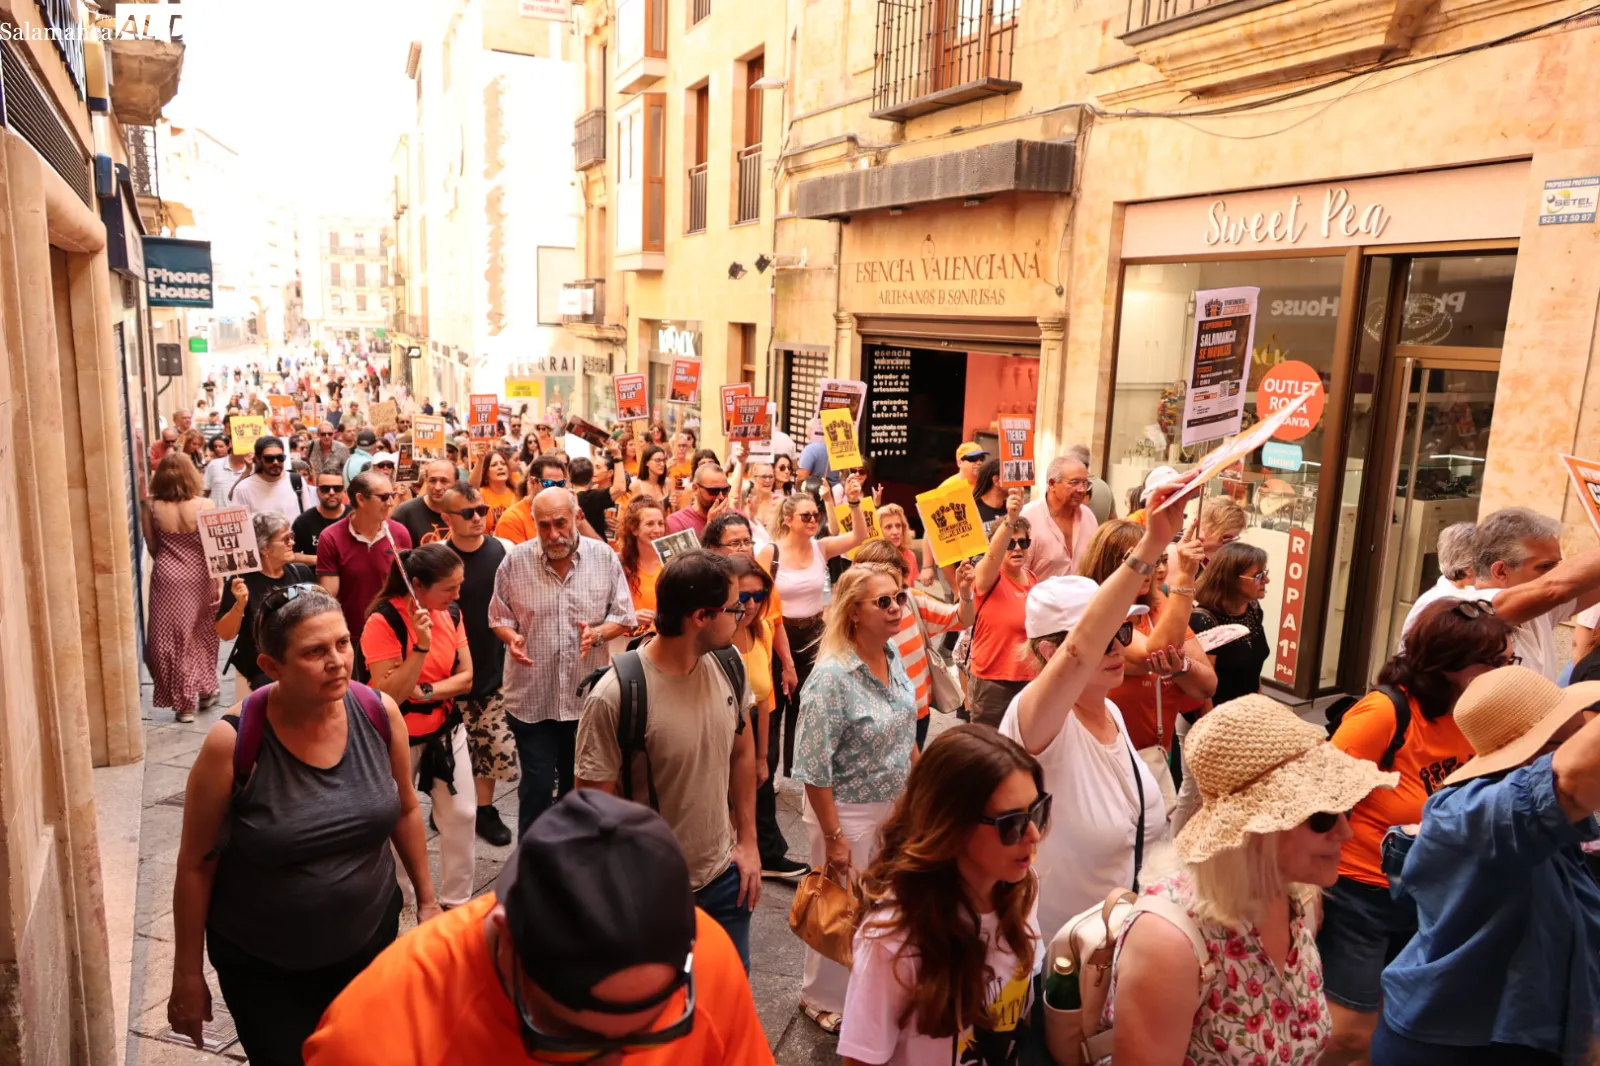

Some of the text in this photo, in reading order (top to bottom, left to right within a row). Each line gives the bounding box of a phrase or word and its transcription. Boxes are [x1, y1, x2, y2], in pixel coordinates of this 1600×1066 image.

[1555, 197, 1592, 206] SETEL
[1204, 187, 1391, 245] Sweet Pea
[1570, 214, 1580, 222] 50
[1581, 213, 1591, 221] 97
[147, 267, 210, 284] Phone
[855, 252, 1041, 283] ESENCIA VALENCIANA
[149, 283, 210, 300] House
[878, 289, 935, 306] ARTESANOS
[948, 288, 1005, 306] SONRISAS
[1200, 330, 1237, 348] SALAMANCA
[874, 349, 911, 358] esencia
[1264, 378, 1318, 396] OUTLET
[1269, 396, 1307, 414] ROA
[478, 413, 488, 422] LEY
[741, 414, 755, 423] LEY
[1010, 443, 1023, 456] LEY
[201, 510, 248, 527] LOS GATOS
[208, 521, 242, 537] TIENEN
[216, 534, 239, 550] LEY
[1283, 536, 1306, 632] ROPA
[1279, 638, 1297, 658] 1ª
[1276, 663, 1294, 677] Pta
